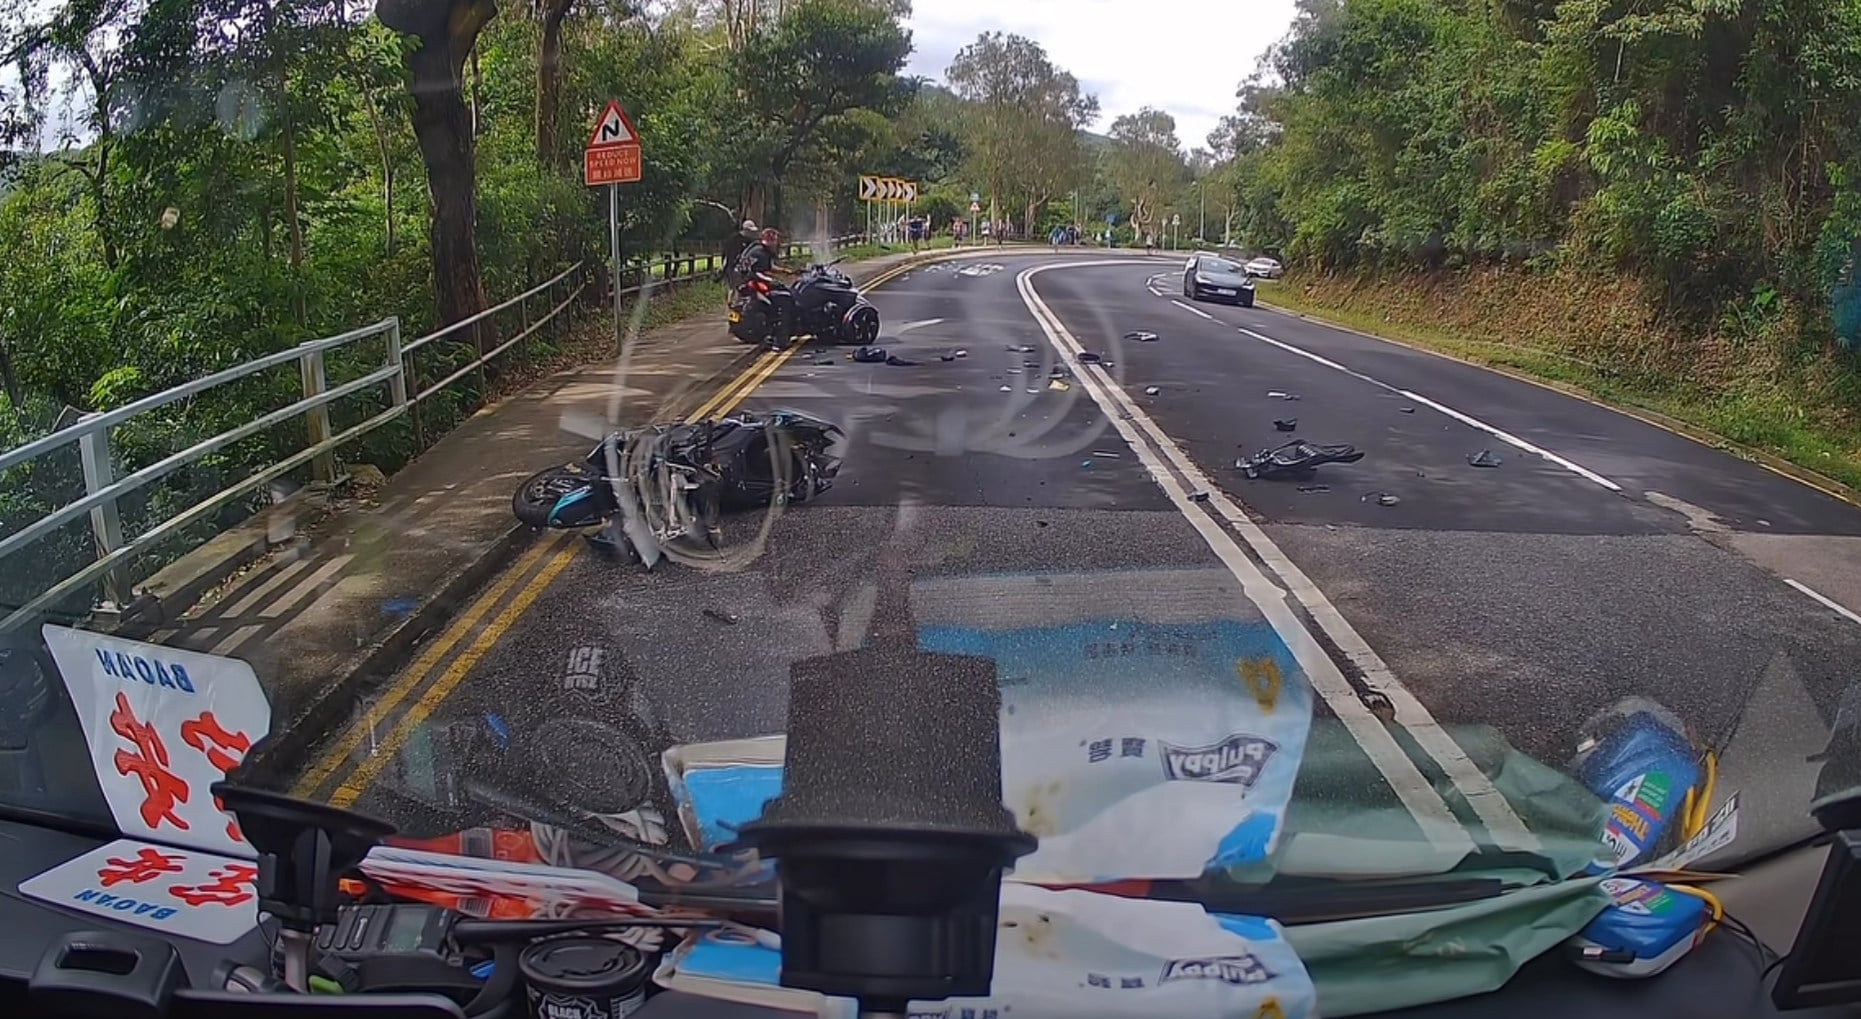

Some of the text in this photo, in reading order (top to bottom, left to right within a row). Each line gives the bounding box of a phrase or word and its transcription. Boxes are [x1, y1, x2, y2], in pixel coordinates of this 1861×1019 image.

[596, 150, 629, 159] REDUCE
[589, 157, 637, 168] SPEED NOW
